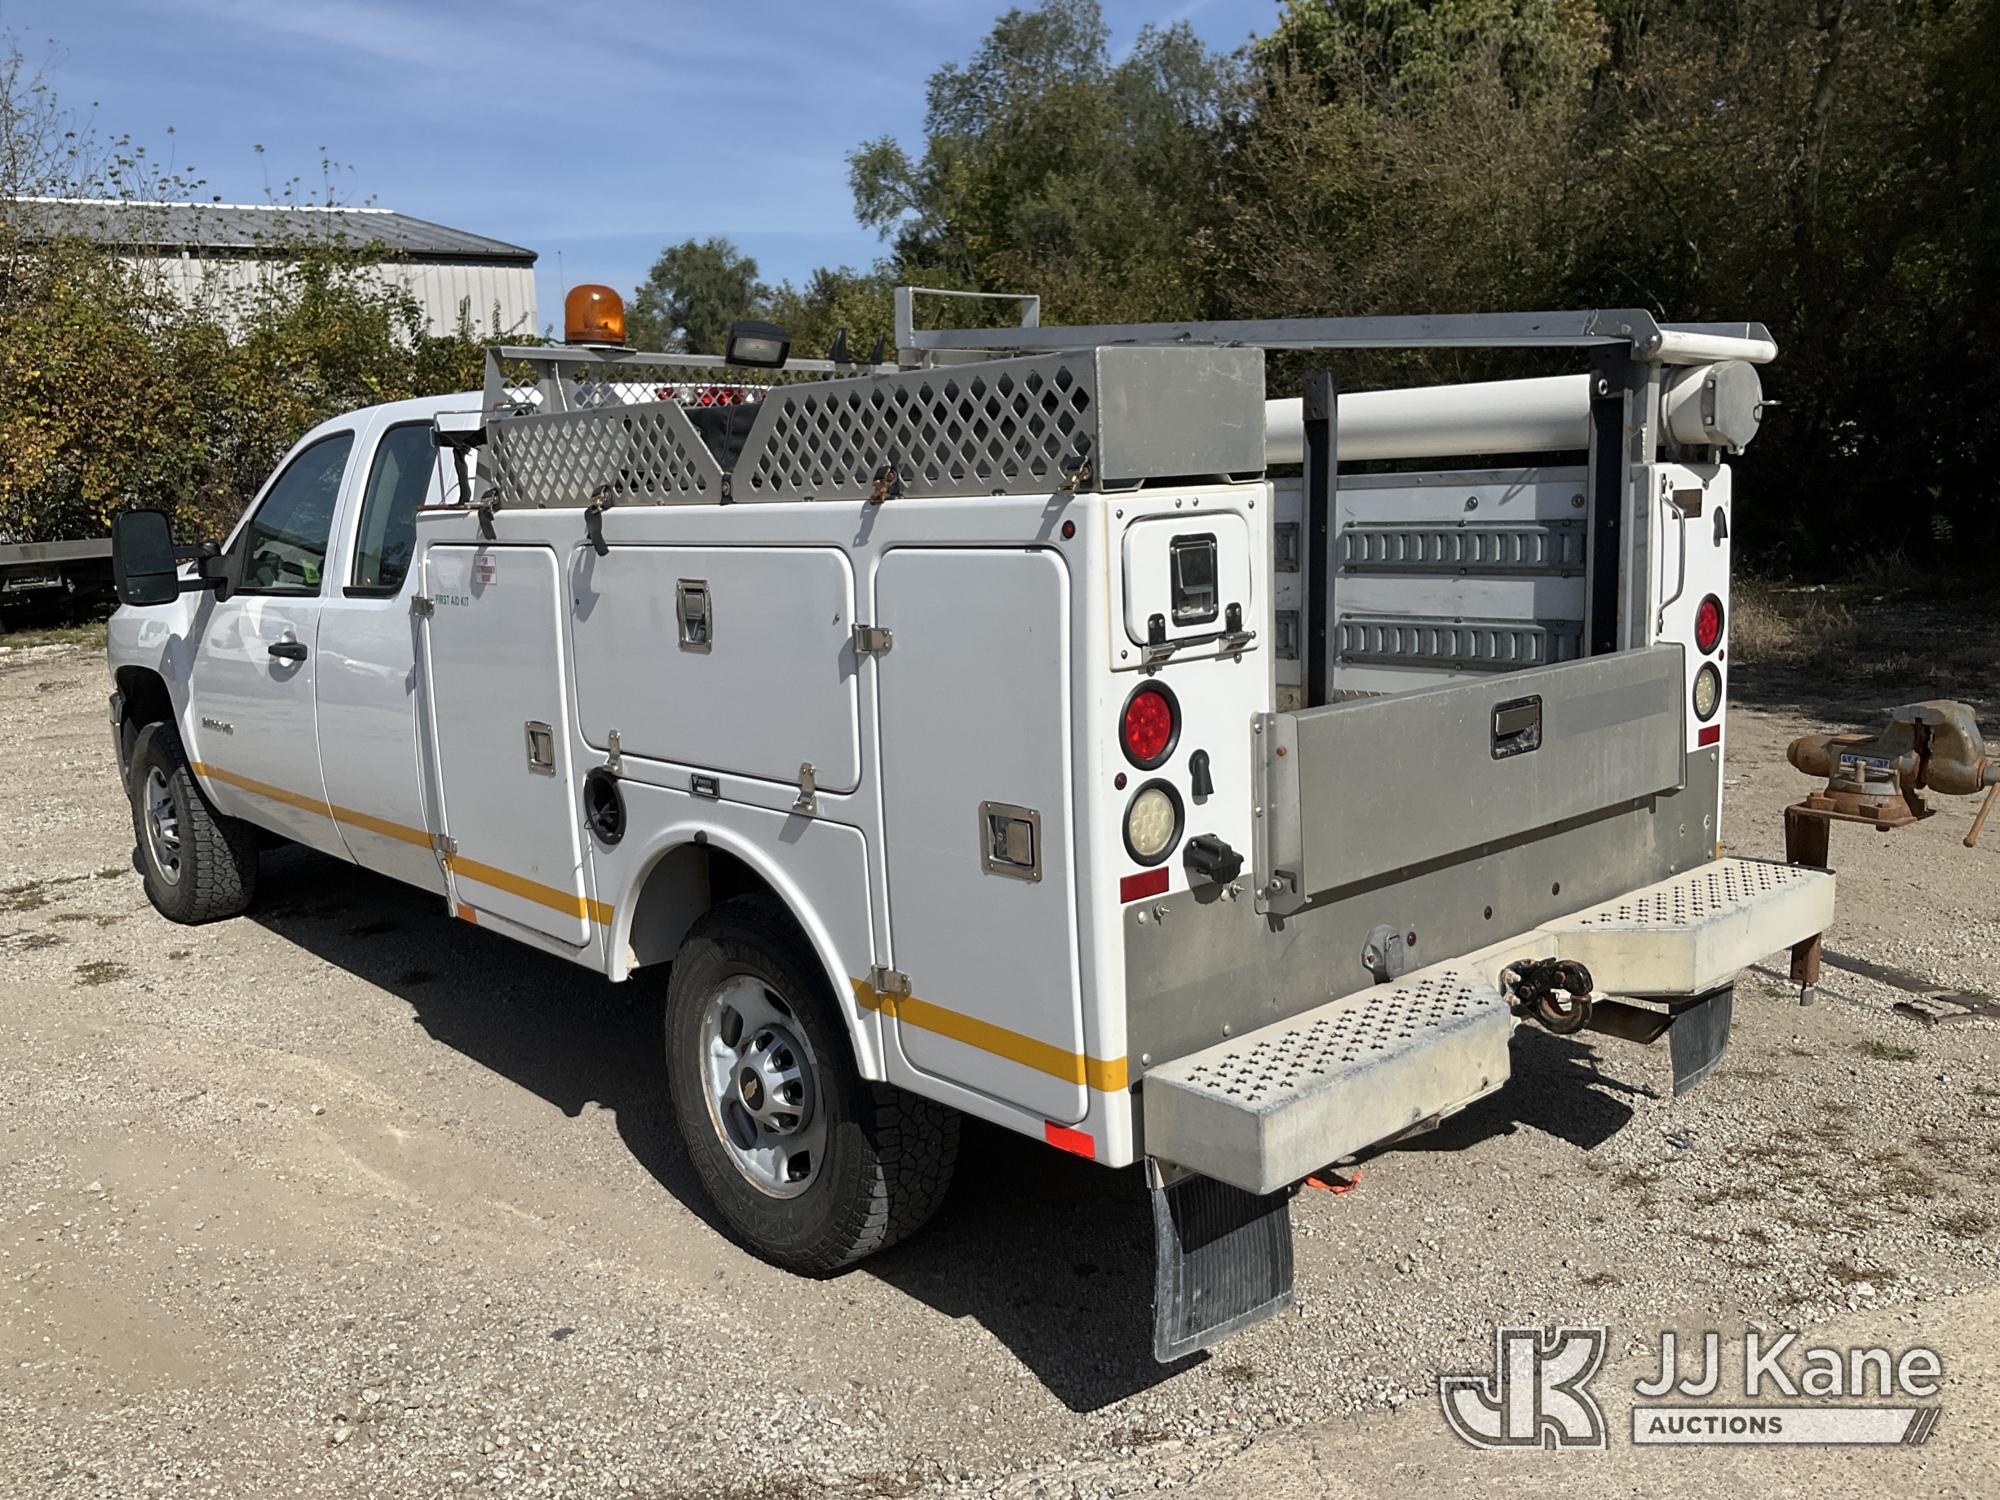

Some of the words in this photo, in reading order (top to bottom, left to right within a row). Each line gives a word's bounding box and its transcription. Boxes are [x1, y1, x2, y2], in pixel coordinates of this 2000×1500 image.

[435, 594, 450, 605] FIRST
[450, 595, 460, 606] AID
[460, 596, 469, 607] KIT
